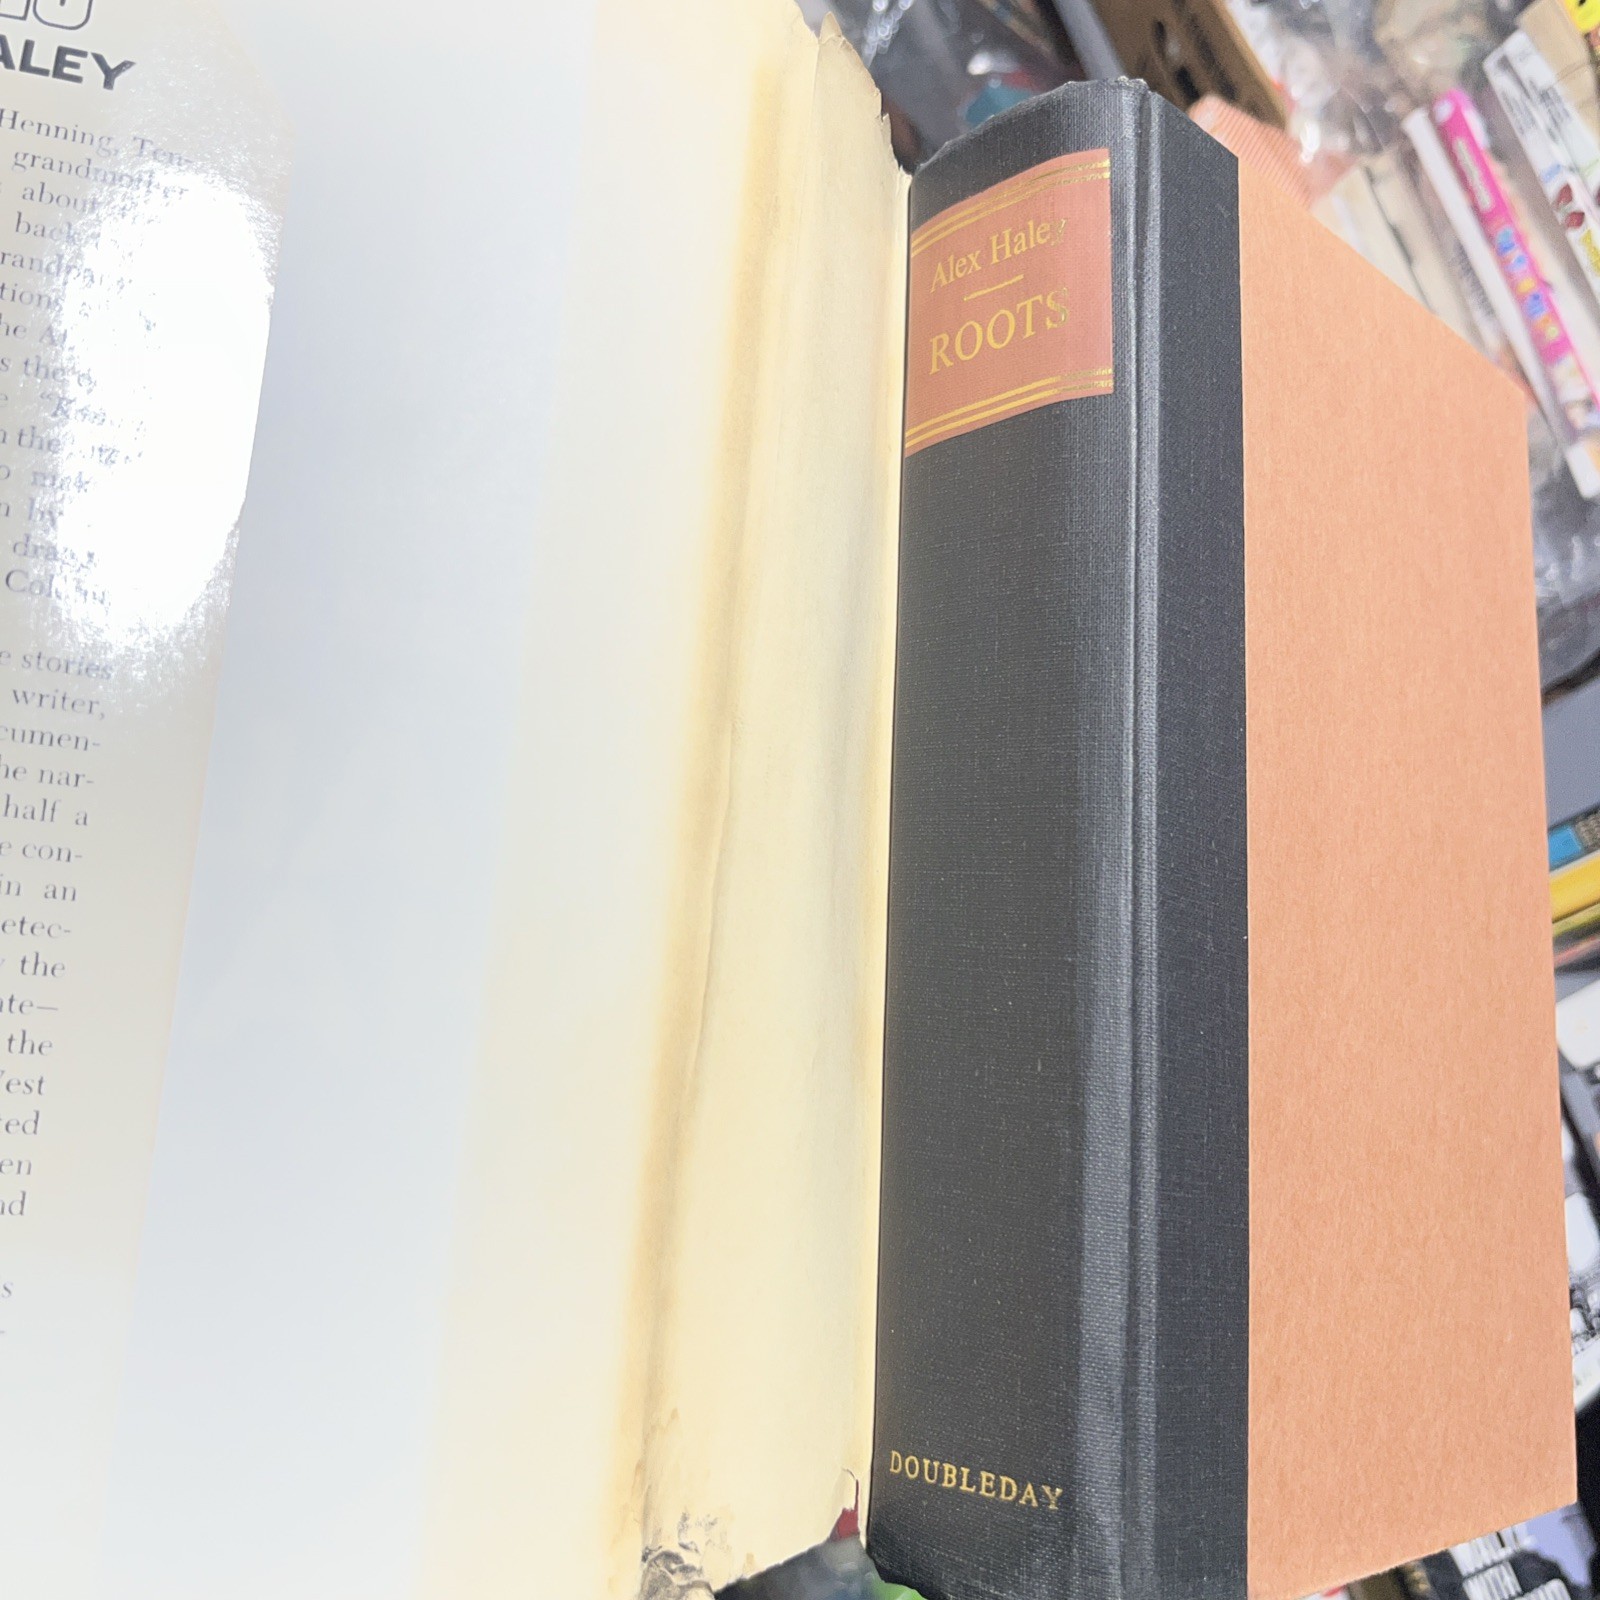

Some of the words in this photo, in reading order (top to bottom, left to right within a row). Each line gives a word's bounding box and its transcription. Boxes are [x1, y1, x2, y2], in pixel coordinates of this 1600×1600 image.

[0, 107, 119, 157] Henning,
[929, 249, 982, 294] Alex
[989, 218, 1067, 264] Haley
[928, 287, 1070, 376] ROOTS
[23, 354, 66, 382] the
[18, 425, 60, 454] the
[21, 650, 113, 681] stories
[12, 687, 105, 720] writer,
[38, 767, 94, 788] nar-
[2, 793, 61, 823] half
[75, 810, 89, 827] a
[21, 842, 83, 864] con-
[43, 883, 77, 902] an
[1, 915, 71, 939] etec-
[20, 950, 66, 979] the
[7, 1029, 53, 1056] the
[889, 1449, 1063, 1510] DOUBLEDAY
